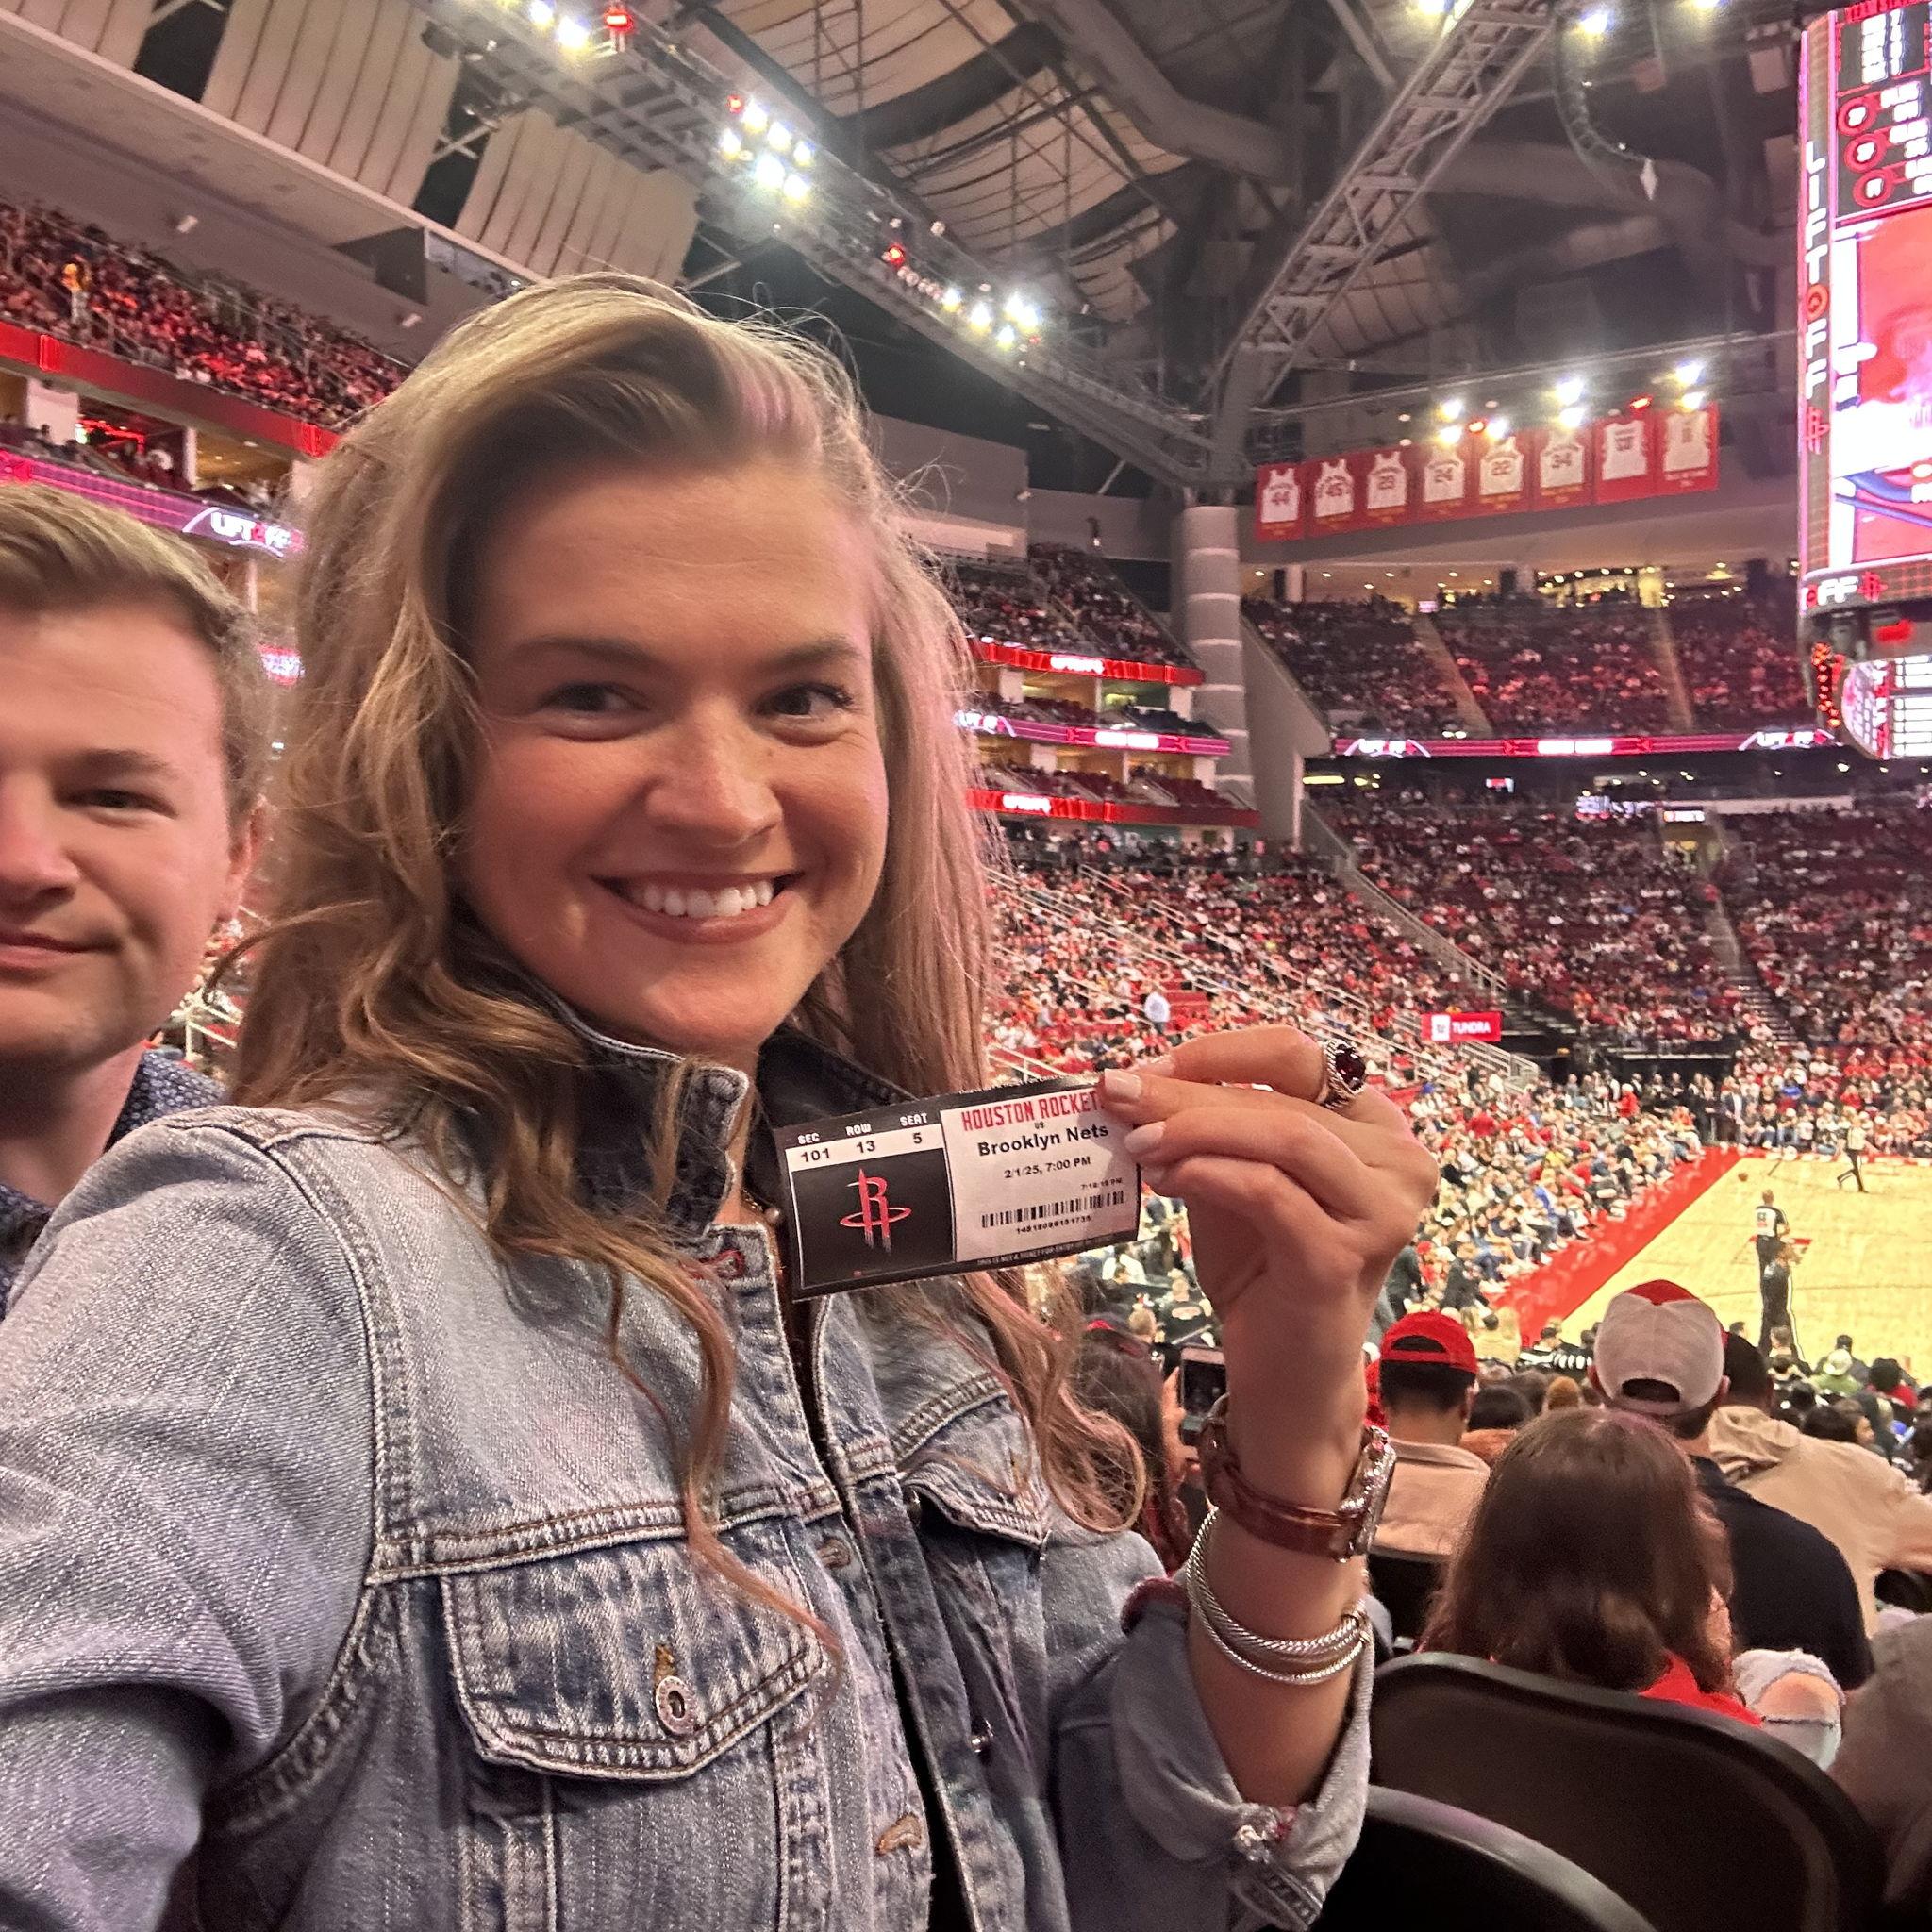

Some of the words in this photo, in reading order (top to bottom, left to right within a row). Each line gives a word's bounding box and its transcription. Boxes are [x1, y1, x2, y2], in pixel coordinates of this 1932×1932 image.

[1452, 1021, 1491, 1034] TUNDRA
[961, 1100, 1034, 1131] HOUSTON
[1039, 1091, 1105, 1119] ROCKET
[797, 1132, 821, 1145] SEC
[845, 1123, 872, 1136] ROW
[899, 1112, 928, 1126] SEAT
[977, 1133, 1060, 1156] Brooklyn
[1066, 1124, 1109, 1142] Nets
[801, 1148, 830, 1162] 101
[856, 1141, 875, 1153] 13
[913, 1132, 922, 1144] 5
[1046, 1159, 1071, 1173] 7:00
[1074, 1157, 1091, 1167] PM
